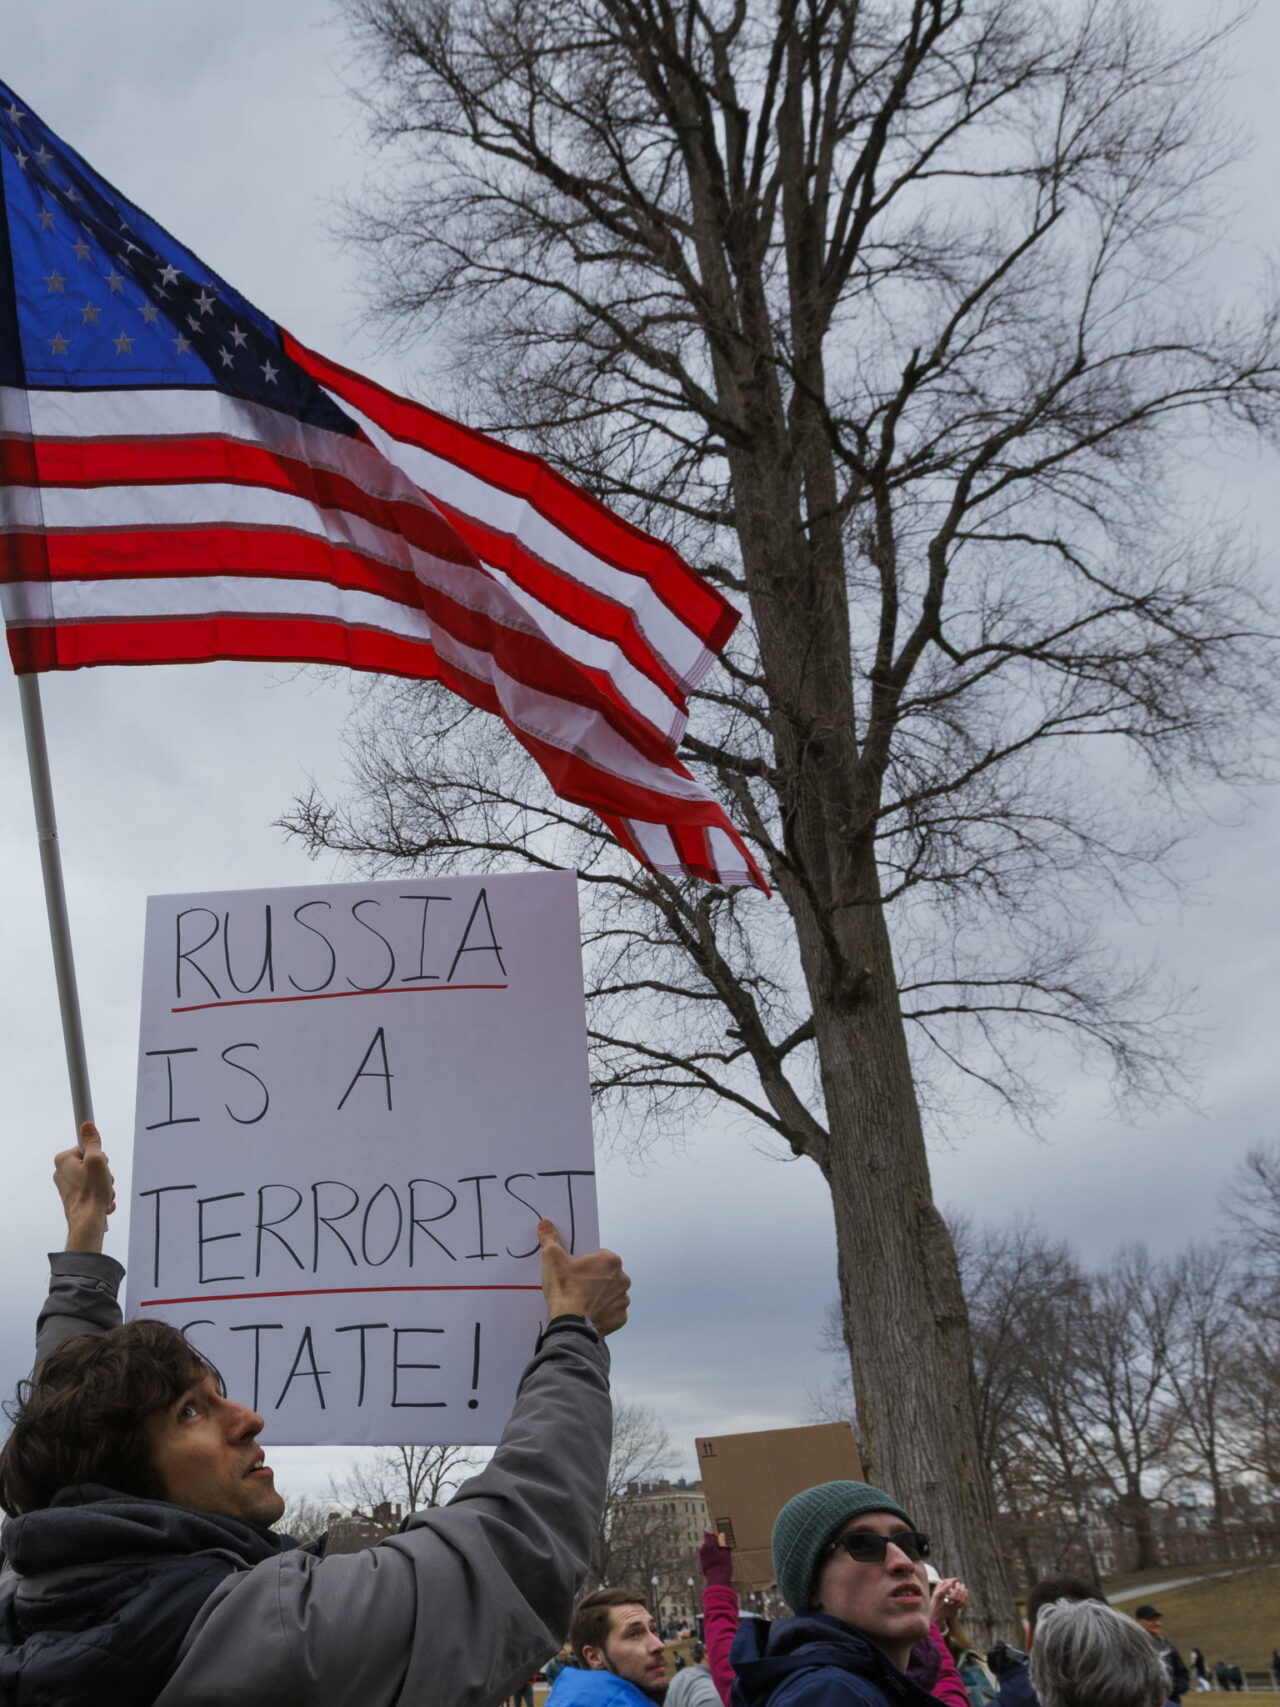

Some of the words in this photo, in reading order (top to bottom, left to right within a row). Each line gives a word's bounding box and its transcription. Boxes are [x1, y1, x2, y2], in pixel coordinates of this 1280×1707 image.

[176, 887, 508, 999] RUSSIA
[145, 1042, 270, 1130] IS
[337, 1026, 395, 1112] A
[139, 1169, 596, 1288] TERRORIST
[180, 1319, 480, 1412] STATE!
